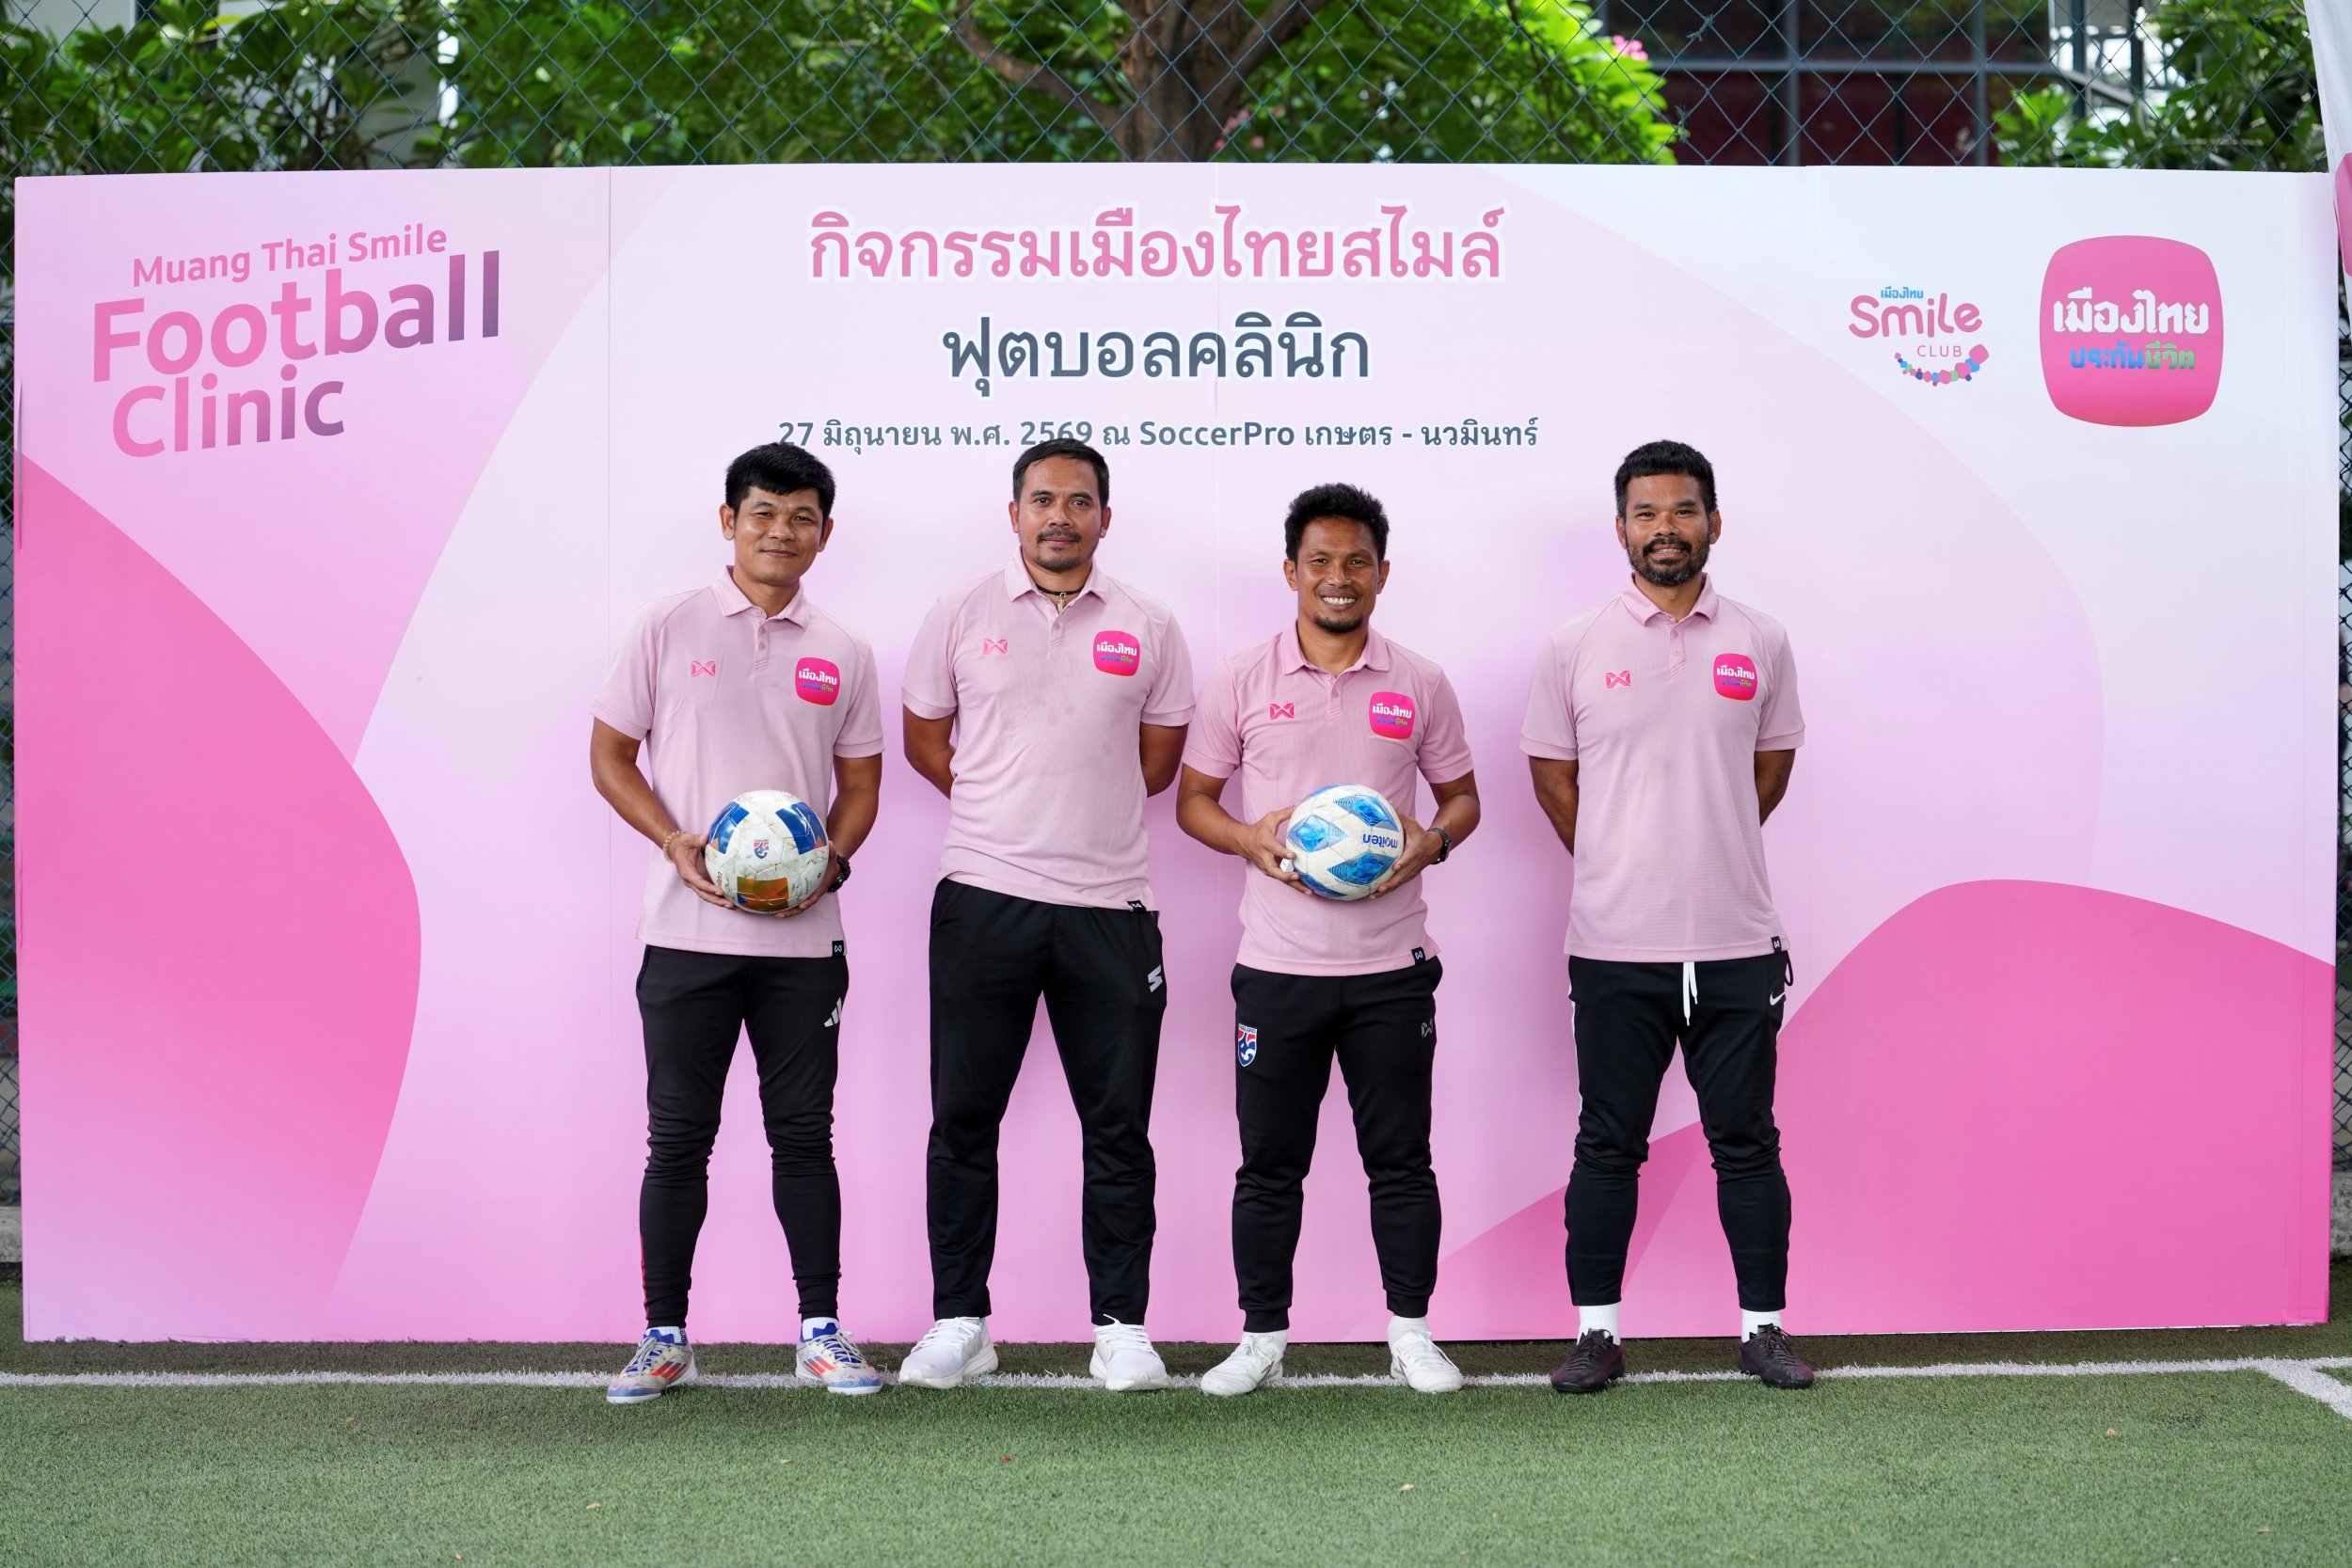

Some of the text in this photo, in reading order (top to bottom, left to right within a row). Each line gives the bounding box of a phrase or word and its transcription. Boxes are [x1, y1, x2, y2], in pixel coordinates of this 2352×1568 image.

[134, 223, 447, 288] Muang Thai Smile
[810, 205, 1503, 279] กิจกรรมเมืองไทยสไมล์
[1881, 285, 1924, 299] เมืองไทย
[2053, 286, 2209, 334] เมืองไทย
[92, 249, 500, 384] Football
[1849, 293, 1983, 339] Smile
[943, 311, 1370, 397] ฟุตบอลคลินิก
[1916, 344, 1963, 357] CLUB
[2069, 340, 2196, 370] ประกันชีวิต
[112, 363, 345, 458] Clinic
[778, 421, 815, 446] 27
[823, 419, 942, 455] มิถุนายน
[951, 424, 1010, 446] พ.ศ.
[1020, 420, 1093, 445] 2569
[1104, 425, 1131, 446] ณ
[1139, 420, 1295, 446] SoccerPro
[1305, 426, 1393, 446] เกษตร
[1421, 417, 1539, 446] นวมินทร์
[1363, 833, 1399, 848] molten
